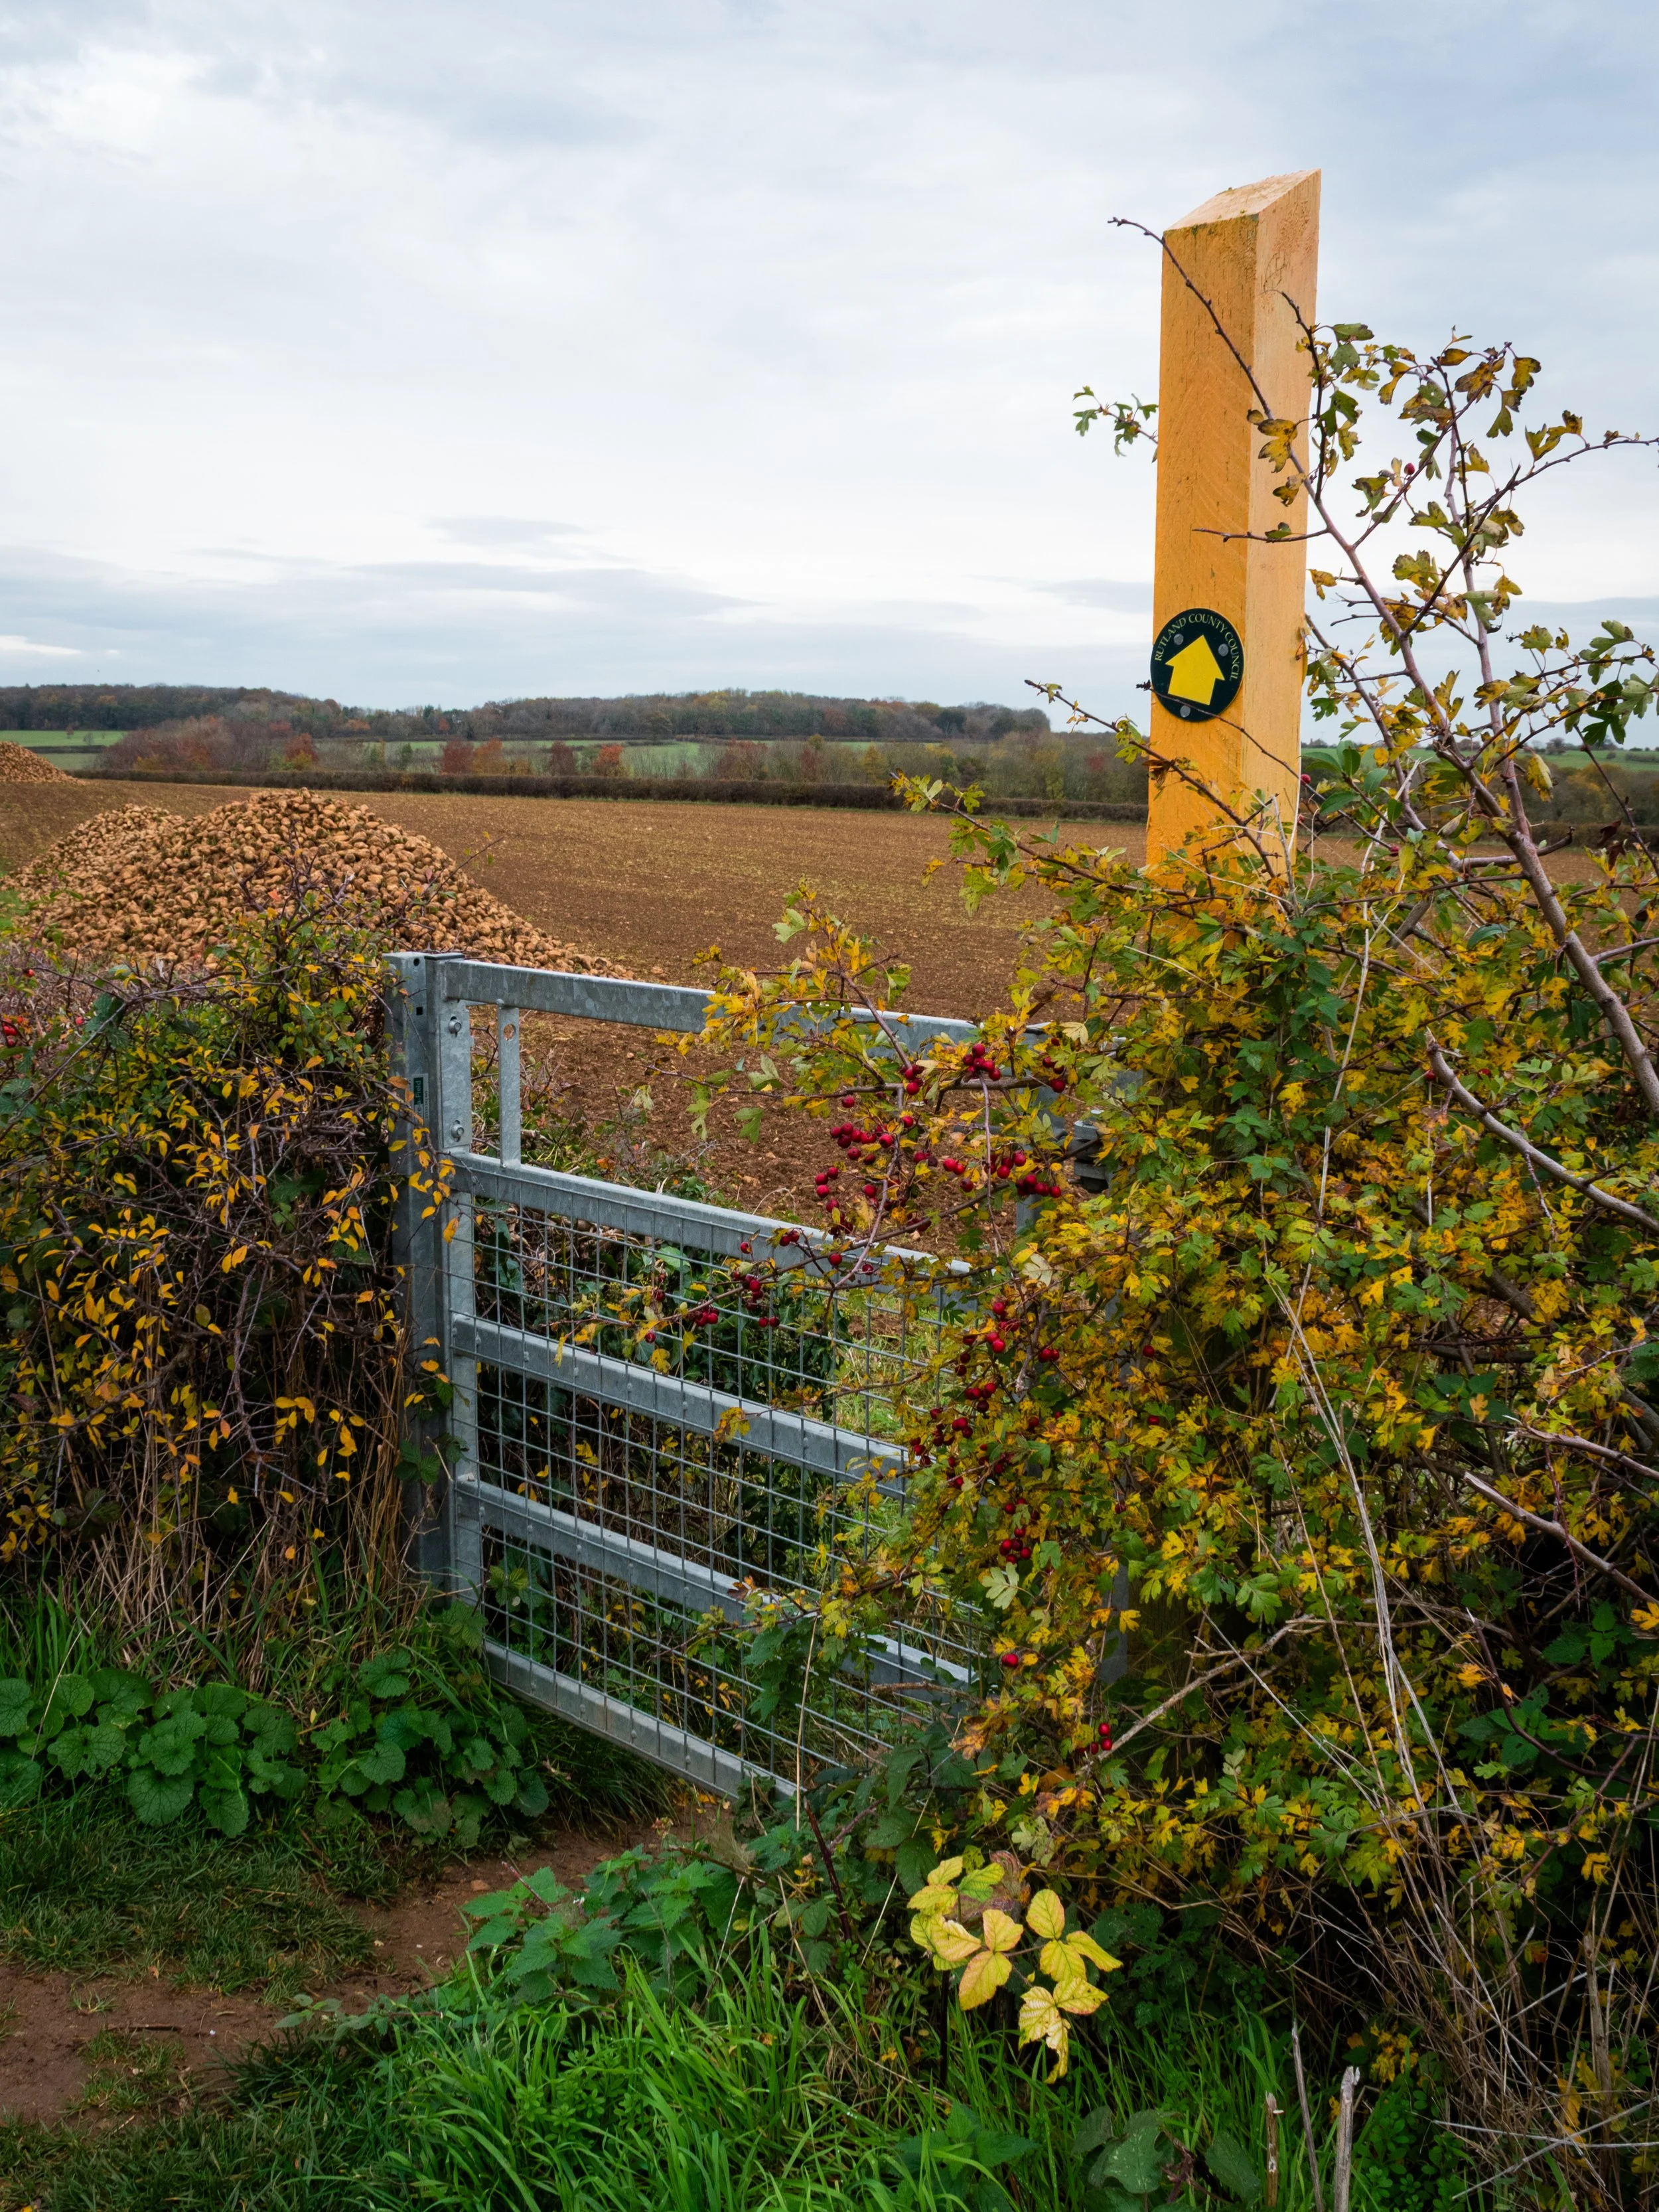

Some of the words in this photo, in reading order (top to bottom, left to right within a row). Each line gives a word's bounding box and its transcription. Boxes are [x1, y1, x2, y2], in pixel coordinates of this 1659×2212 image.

[1155, 617, 1187, 662] RUTLAND
[1189, 613, 1228, 633] COUNTY
[1224, 631, 1240, 681] COUNCIL
